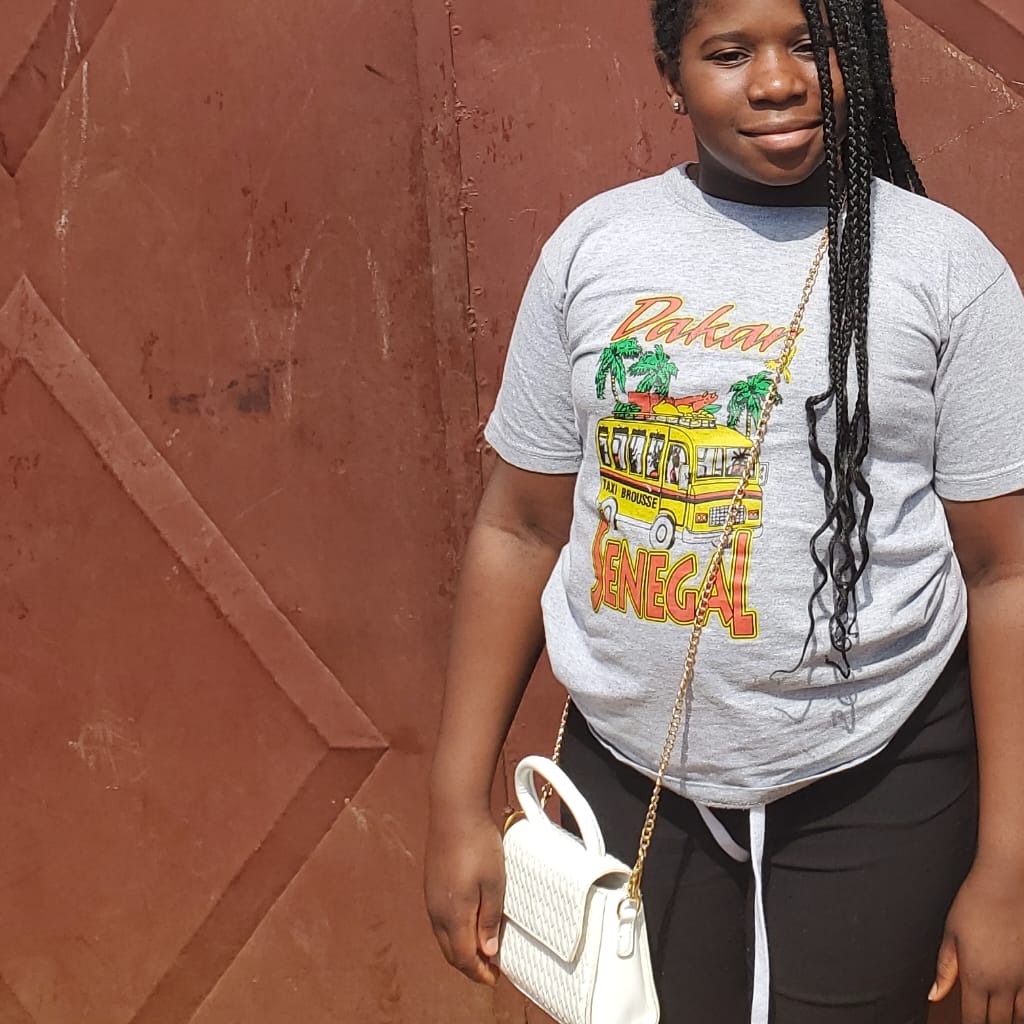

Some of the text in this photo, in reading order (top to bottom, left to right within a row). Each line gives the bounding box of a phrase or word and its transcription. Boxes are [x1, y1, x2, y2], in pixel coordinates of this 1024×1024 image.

[610, 294, 804, 353] Dakar
[602, 478, 658, 509] TAXI BROUSSE
